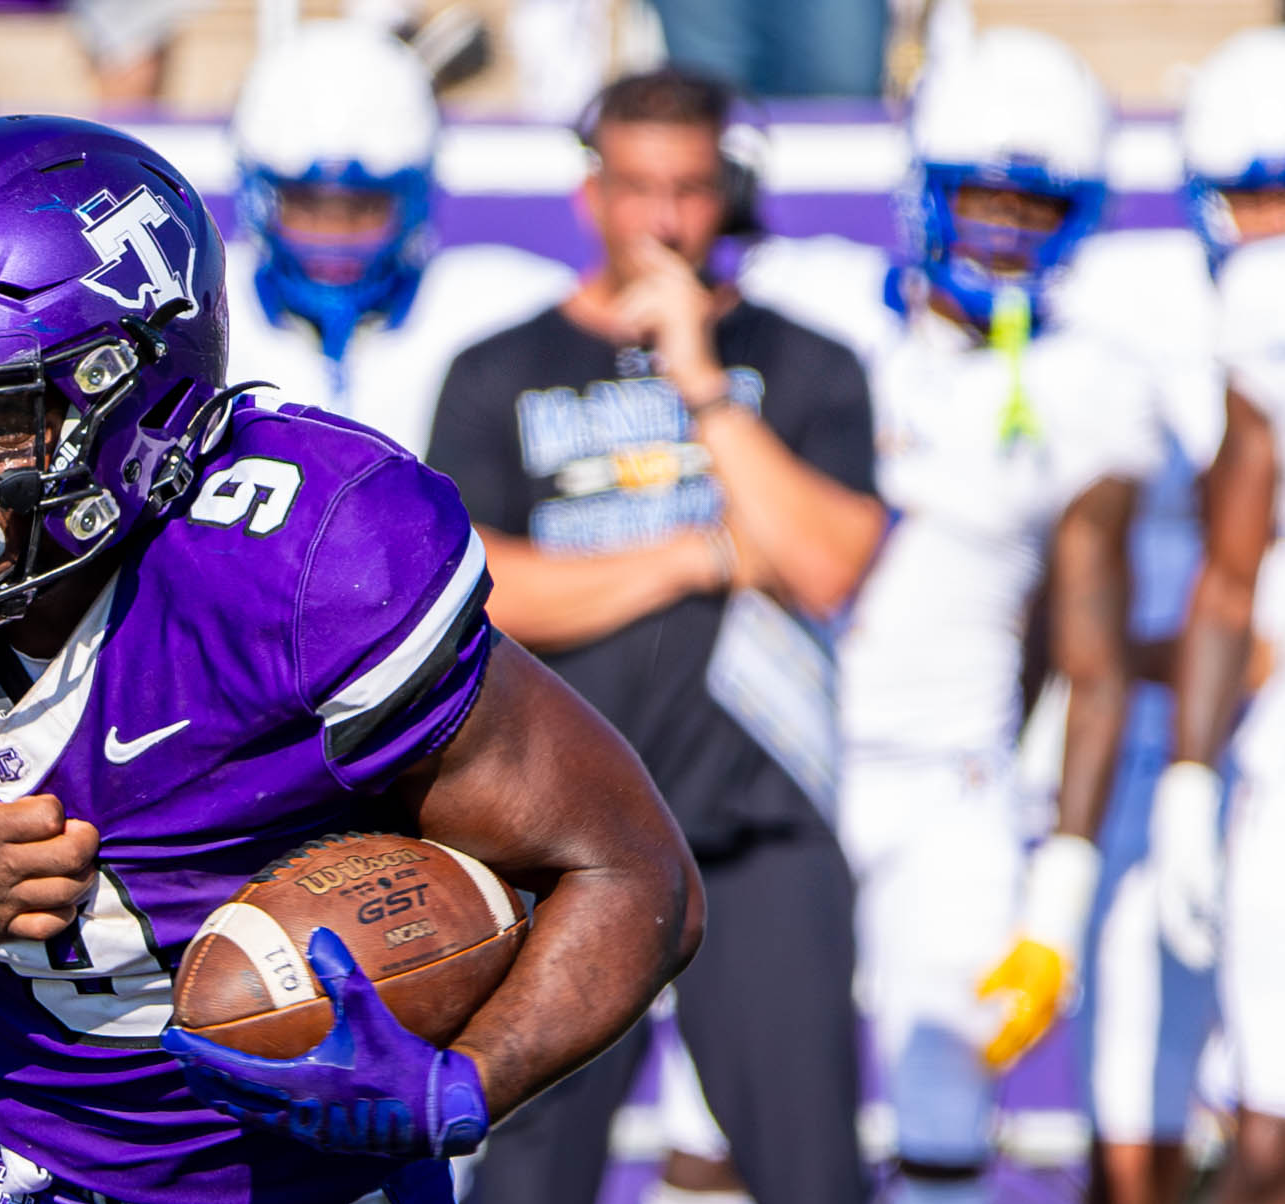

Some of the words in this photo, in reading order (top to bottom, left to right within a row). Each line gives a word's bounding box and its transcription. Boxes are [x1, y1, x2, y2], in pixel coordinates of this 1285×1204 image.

[187, 455, 304, 539] 9
[294, 849, 429, 895] Wilson
[357, 882, 429, 925] GST
